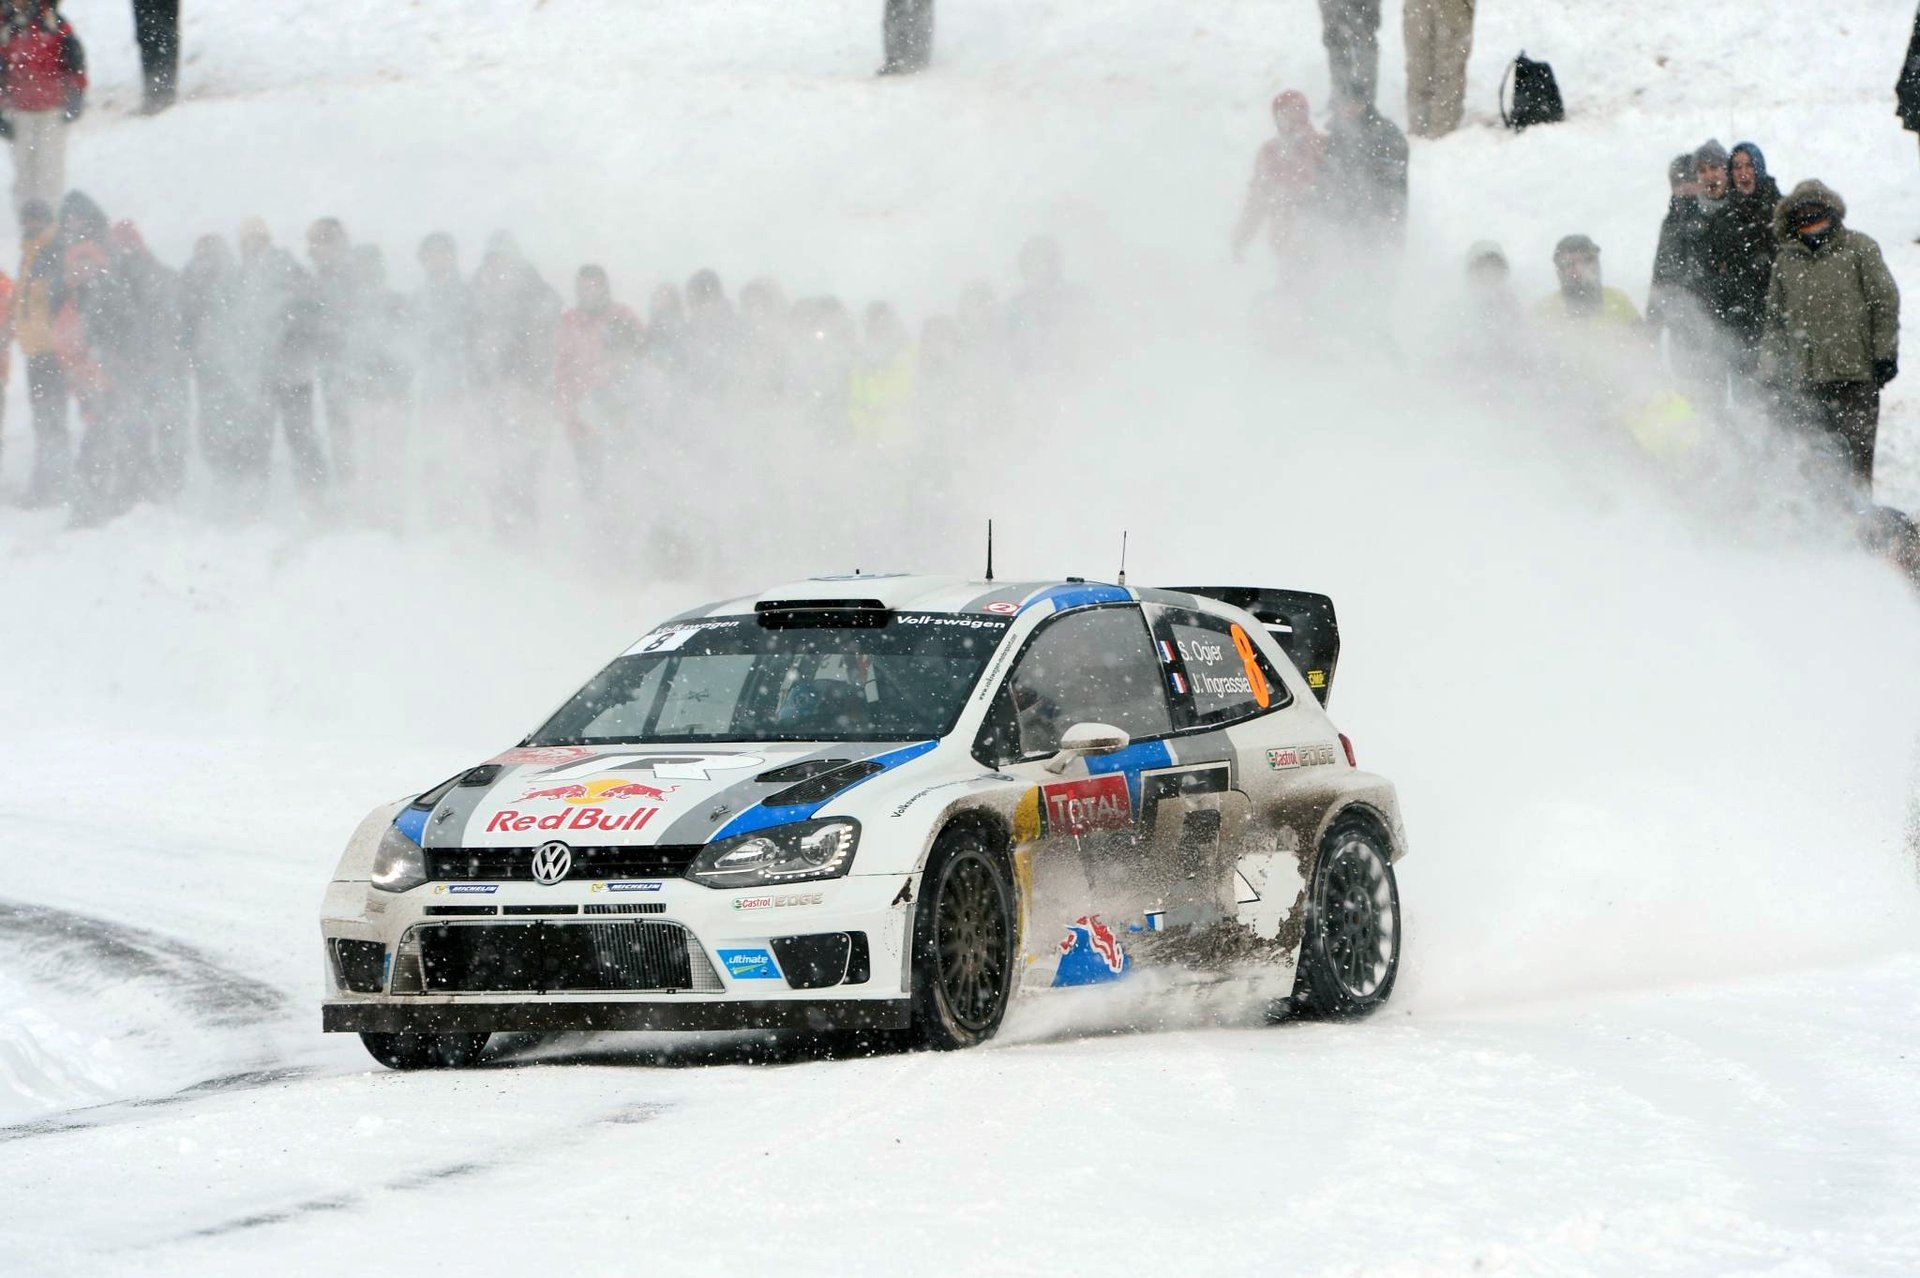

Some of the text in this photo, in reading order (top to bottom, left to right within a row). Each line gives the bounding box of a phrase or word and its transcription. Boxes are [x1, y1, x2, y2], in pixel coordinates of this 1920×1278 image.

[643, 632, 675, 652] 8
[1177, 640, 1224, 666] S. Ogier
[1230, 623, 1270, 709] 8
[1202, 673, 1253, 698] Ingrassia
[486, 806, 659, 832] Red Bull
[1050, 792, 1124, 827] TOTAL
[608, 882, 660, 891] MICHELIN
[742, 892, 823, 908] Castrol EDGE
[729, 955, 768, 964] ultimate
